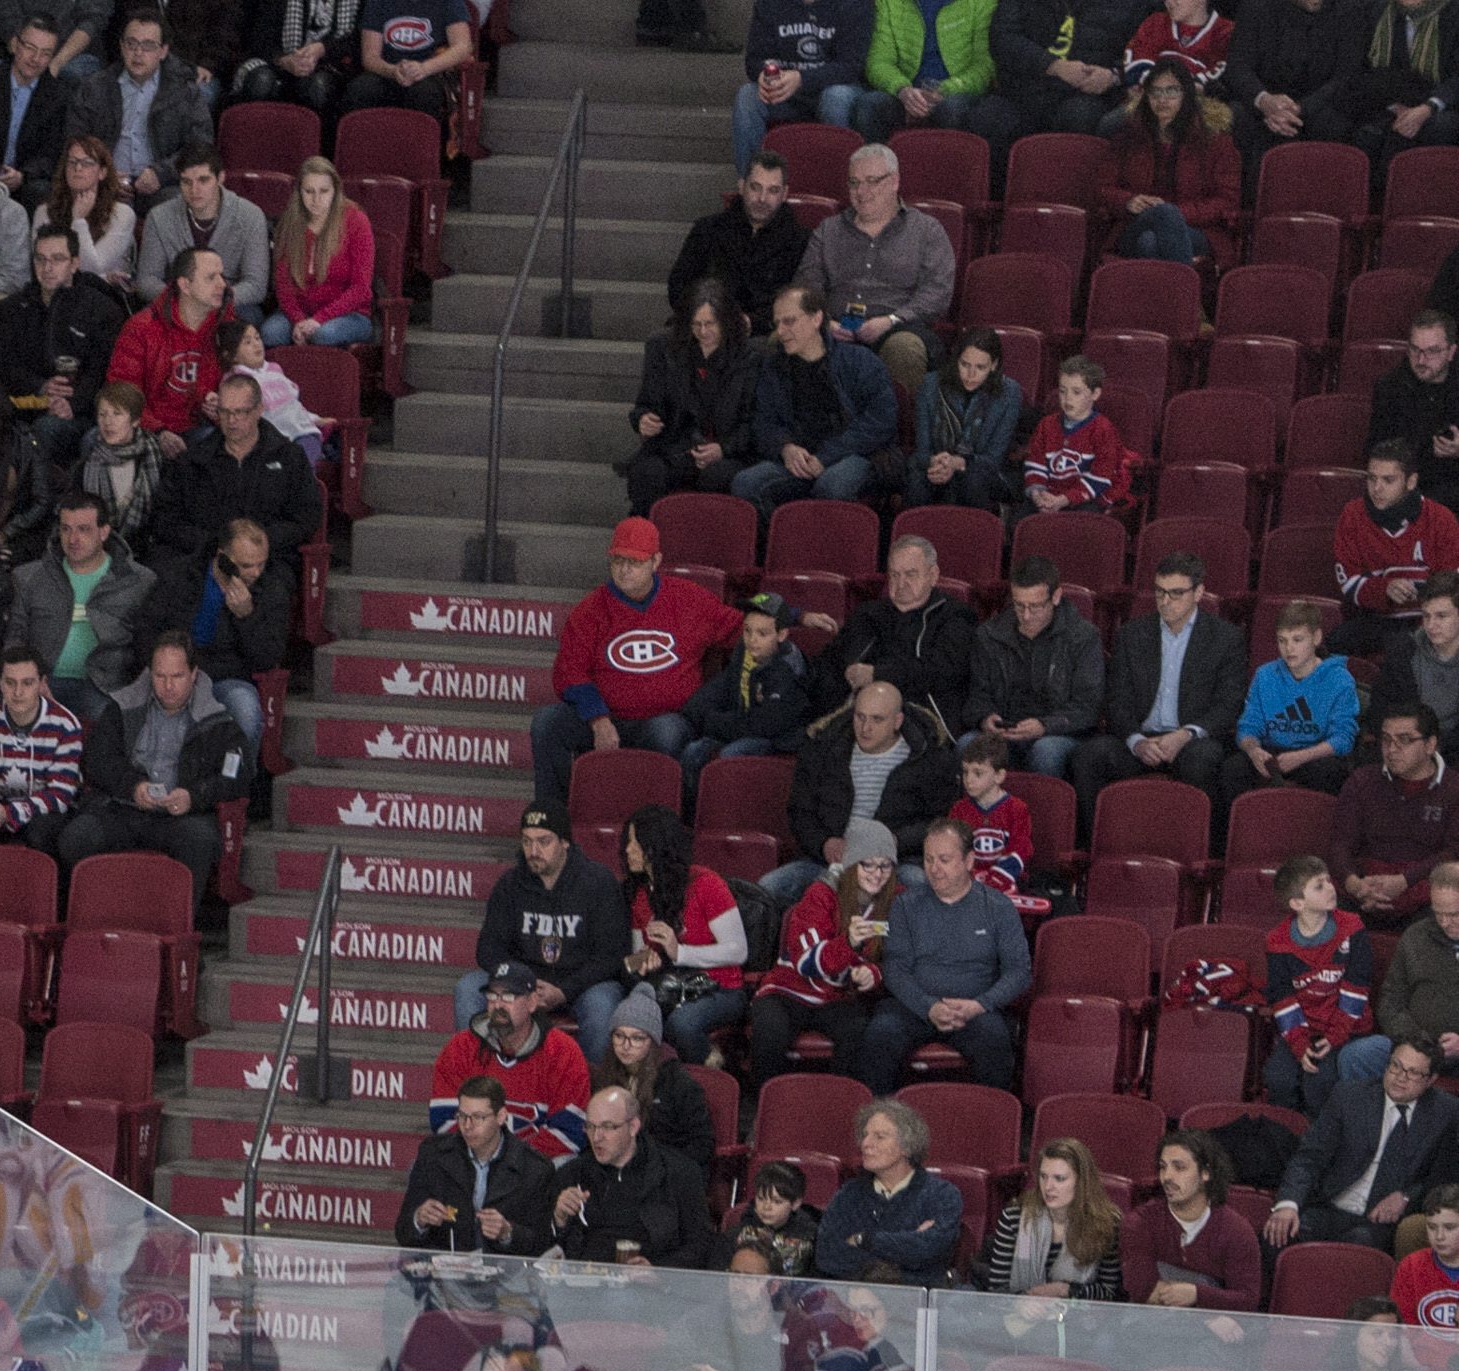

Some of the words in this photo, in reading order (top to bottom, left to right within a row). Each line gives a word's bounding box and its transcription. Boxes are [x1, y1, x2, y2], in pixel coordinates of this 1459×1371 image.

[1413, 541, 1423, 561] A
[446, 605, 553, 637] CANADIAN
[418, 670, 526, 701] CANADIAN
[1266, 715, 1320, 735] adidas
[401, 733, 509, 765] CANADIAN
[375, 801, 483, 833] CANADIAN
[363, 865, 473, 897] CANADIAN
[522, 911, 582, 938] FDNY
[335, 930, 444, 963] CANADIAN
[330, 998, 427, 1030] ANADIAN
[282, 1064, 405, 1099] CDIAN
[281, 1134, 392, 1167] CANADIAN
[260, 1191, 372, 1226] CANADIAN
[252, 1252, 347, 1285] ANADIAN
[229, 1308, 338, 1342] CNADIAN
